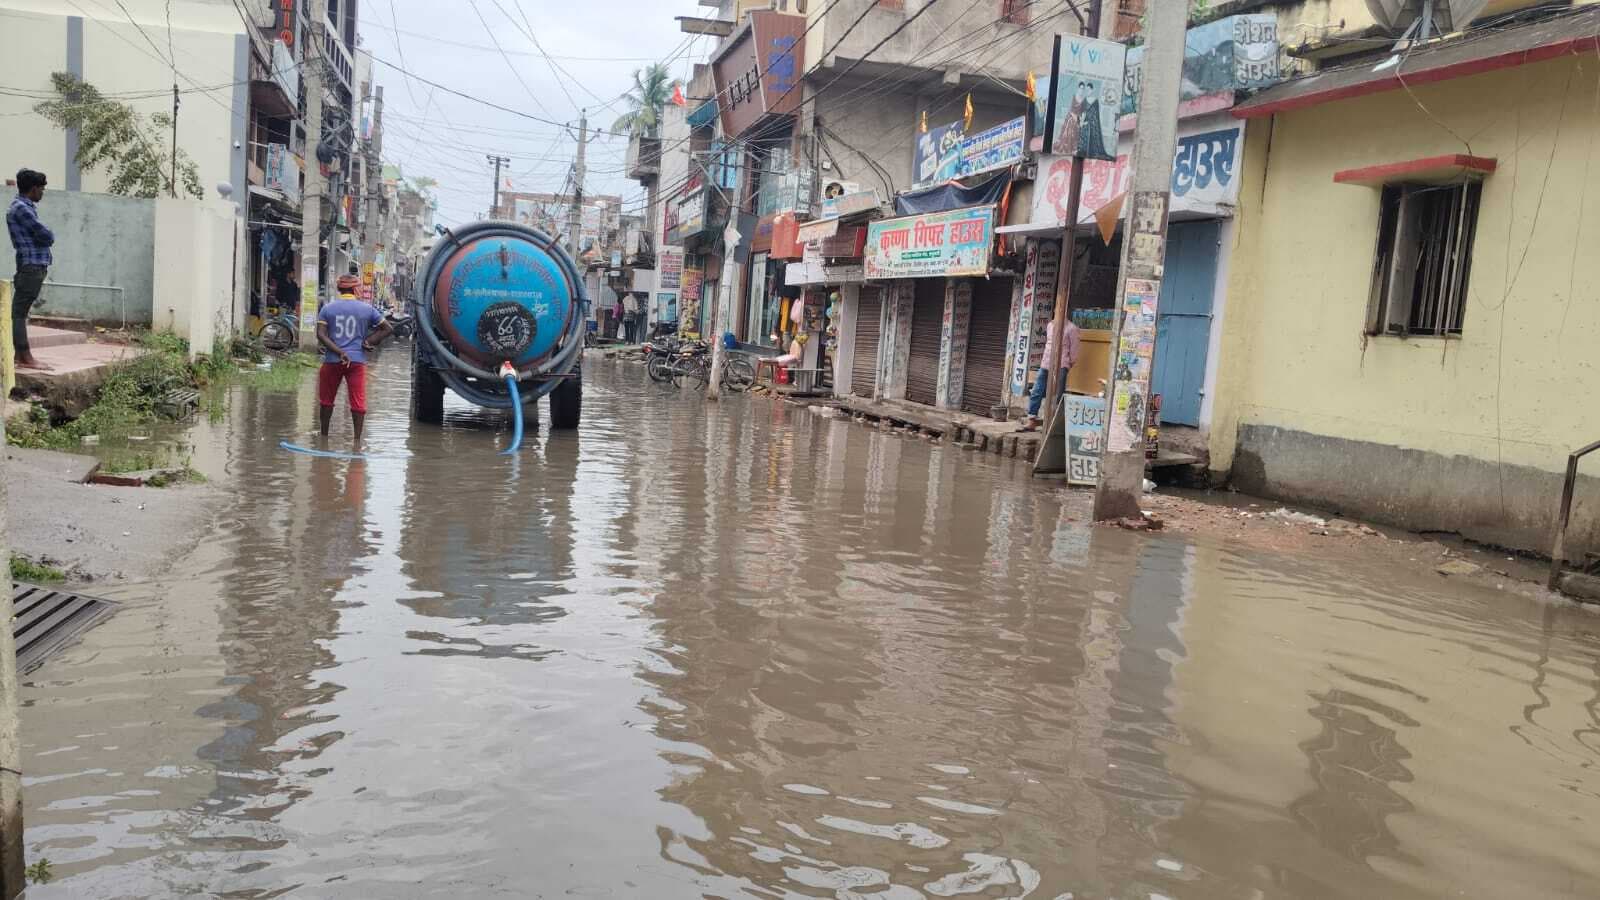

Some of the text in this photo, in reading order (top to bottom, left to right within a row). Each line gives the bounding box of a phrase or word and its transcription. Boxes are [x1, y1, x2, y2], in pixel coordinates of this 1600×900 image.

[1172, 127, 1239, 197] हाउस
[880, 218, 986, 258] कृष्णा गिफ्ट हाउस
[335, 315, 356, 338] 50
